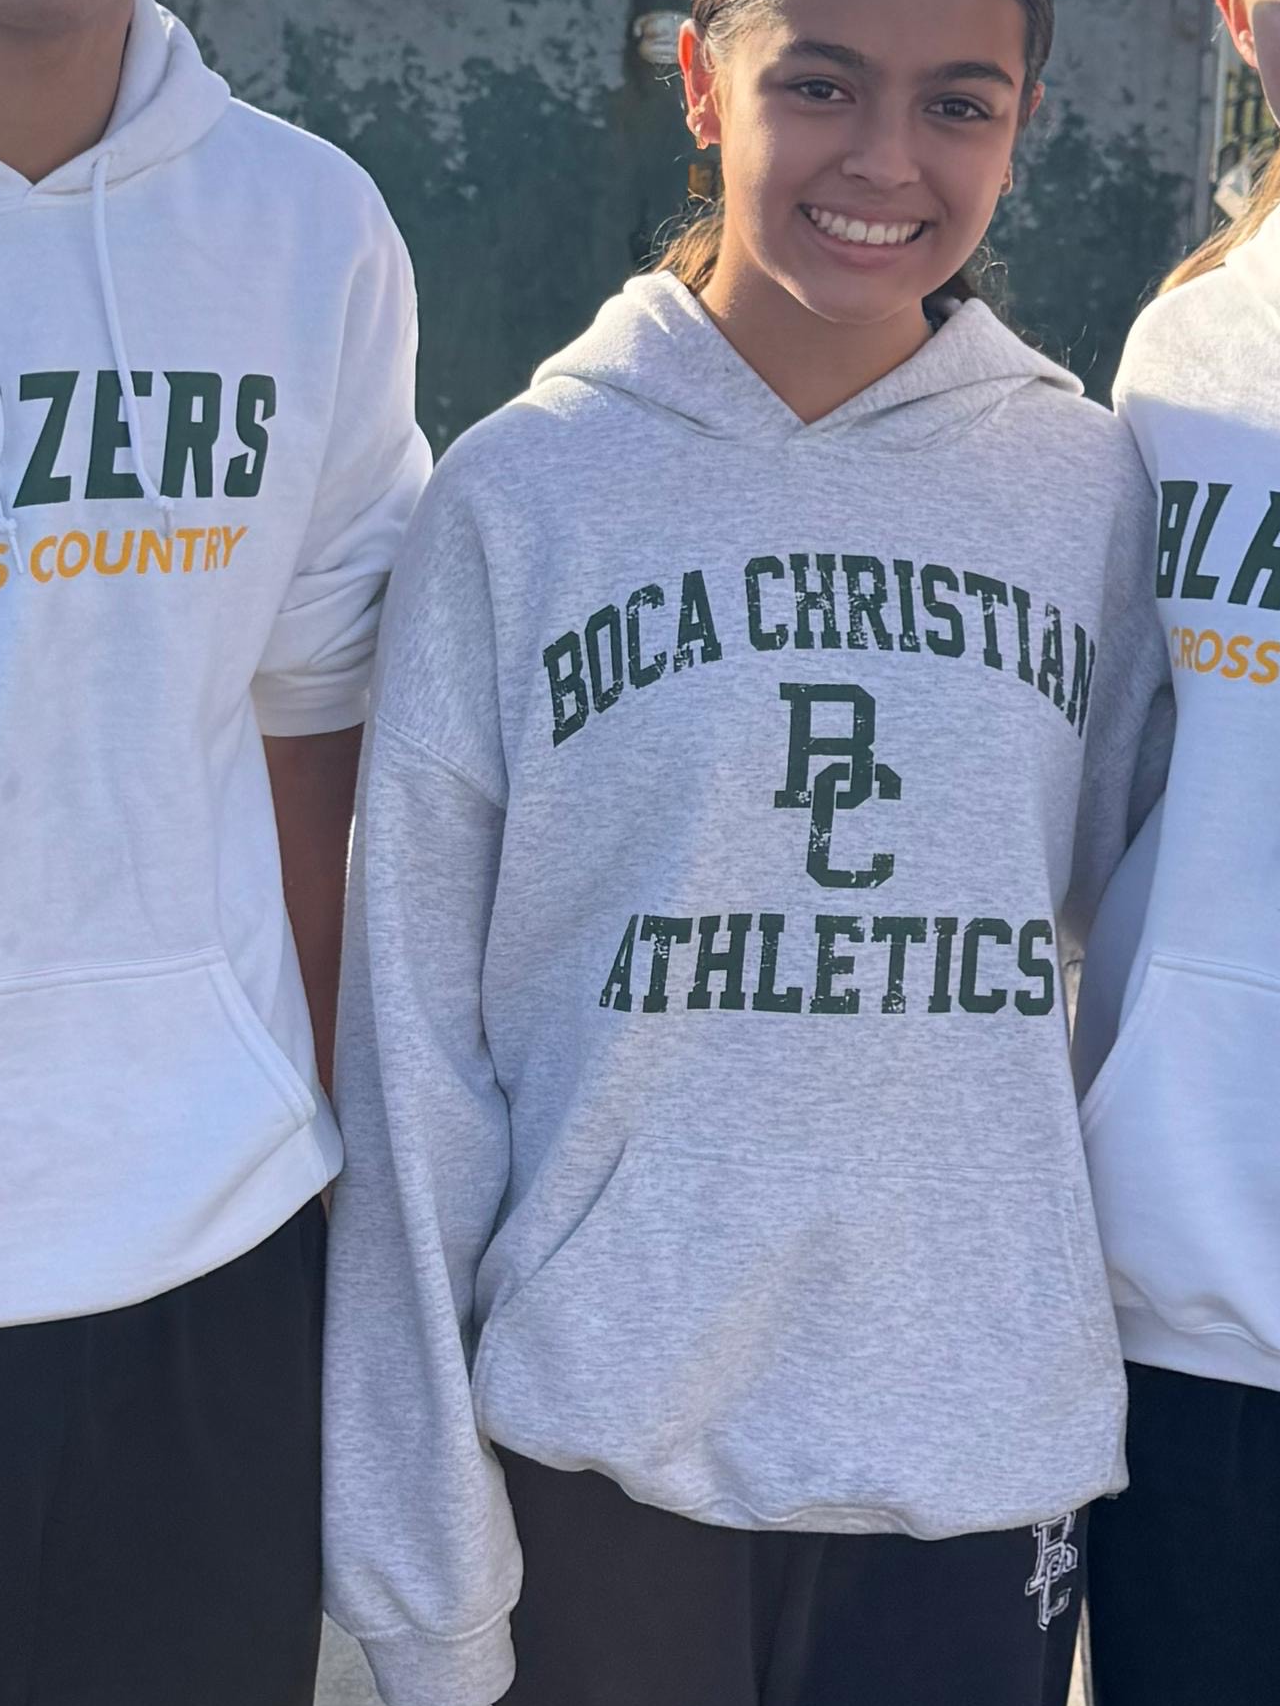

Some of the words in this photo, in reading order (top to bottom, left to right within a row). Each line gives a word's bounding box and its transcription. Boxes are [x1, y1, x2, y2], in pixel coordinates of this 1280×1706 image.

[29, 525, 250, 584] COUNTRY
[542, 569, 722, 748] BOCA
[744, 552, 1096, 739] CHRISTIAN
[598, 913, 1055, 1017] ATHLETICS
